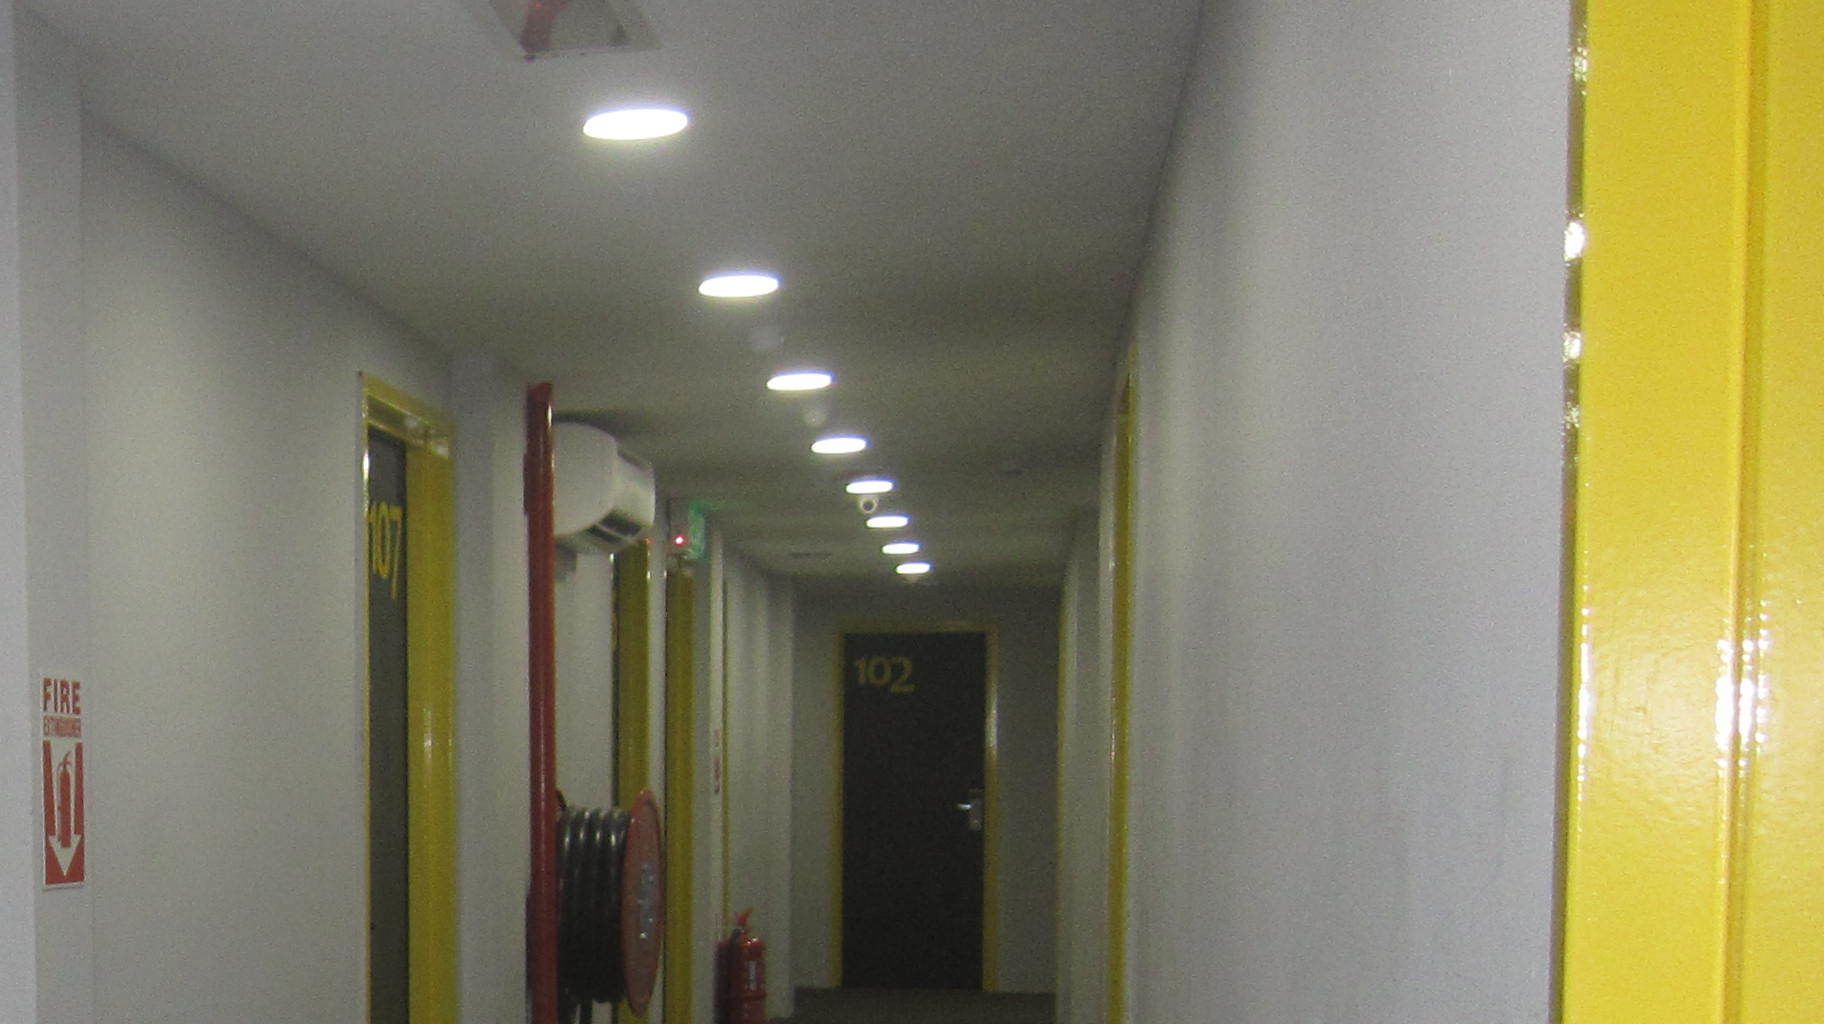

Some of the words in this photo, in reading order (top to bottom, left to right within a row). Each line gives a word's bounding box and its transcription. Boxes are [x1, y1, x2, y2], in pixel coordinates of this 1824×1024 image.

[368, 502, 402, 600] 107
[855, 656, 916, 694] 102
[43, 677, 81, 714] FIRE
